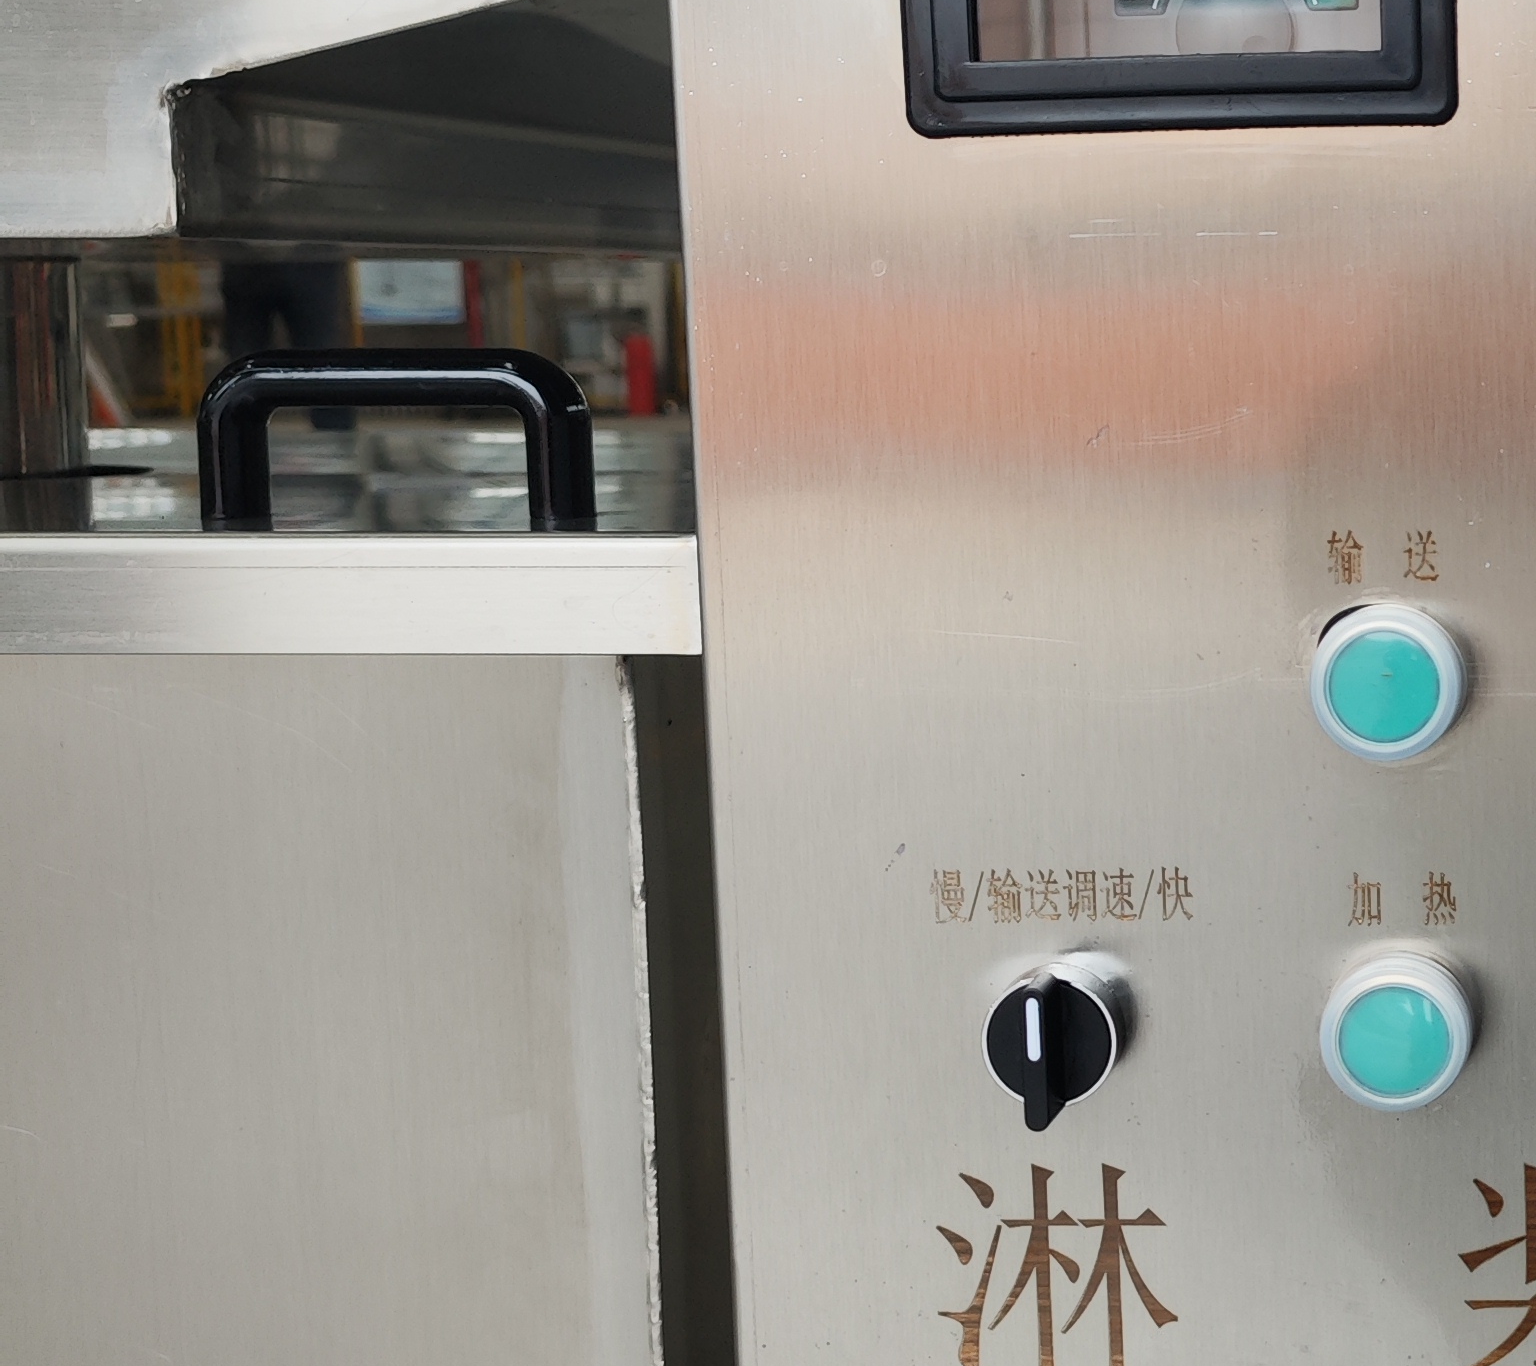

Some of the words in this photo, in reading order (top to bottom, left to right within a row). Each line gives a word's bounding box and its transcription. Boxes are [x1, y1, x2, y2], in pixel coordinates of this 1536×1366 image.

[928, 866, 1194, 925] 慢/输送调速/快
